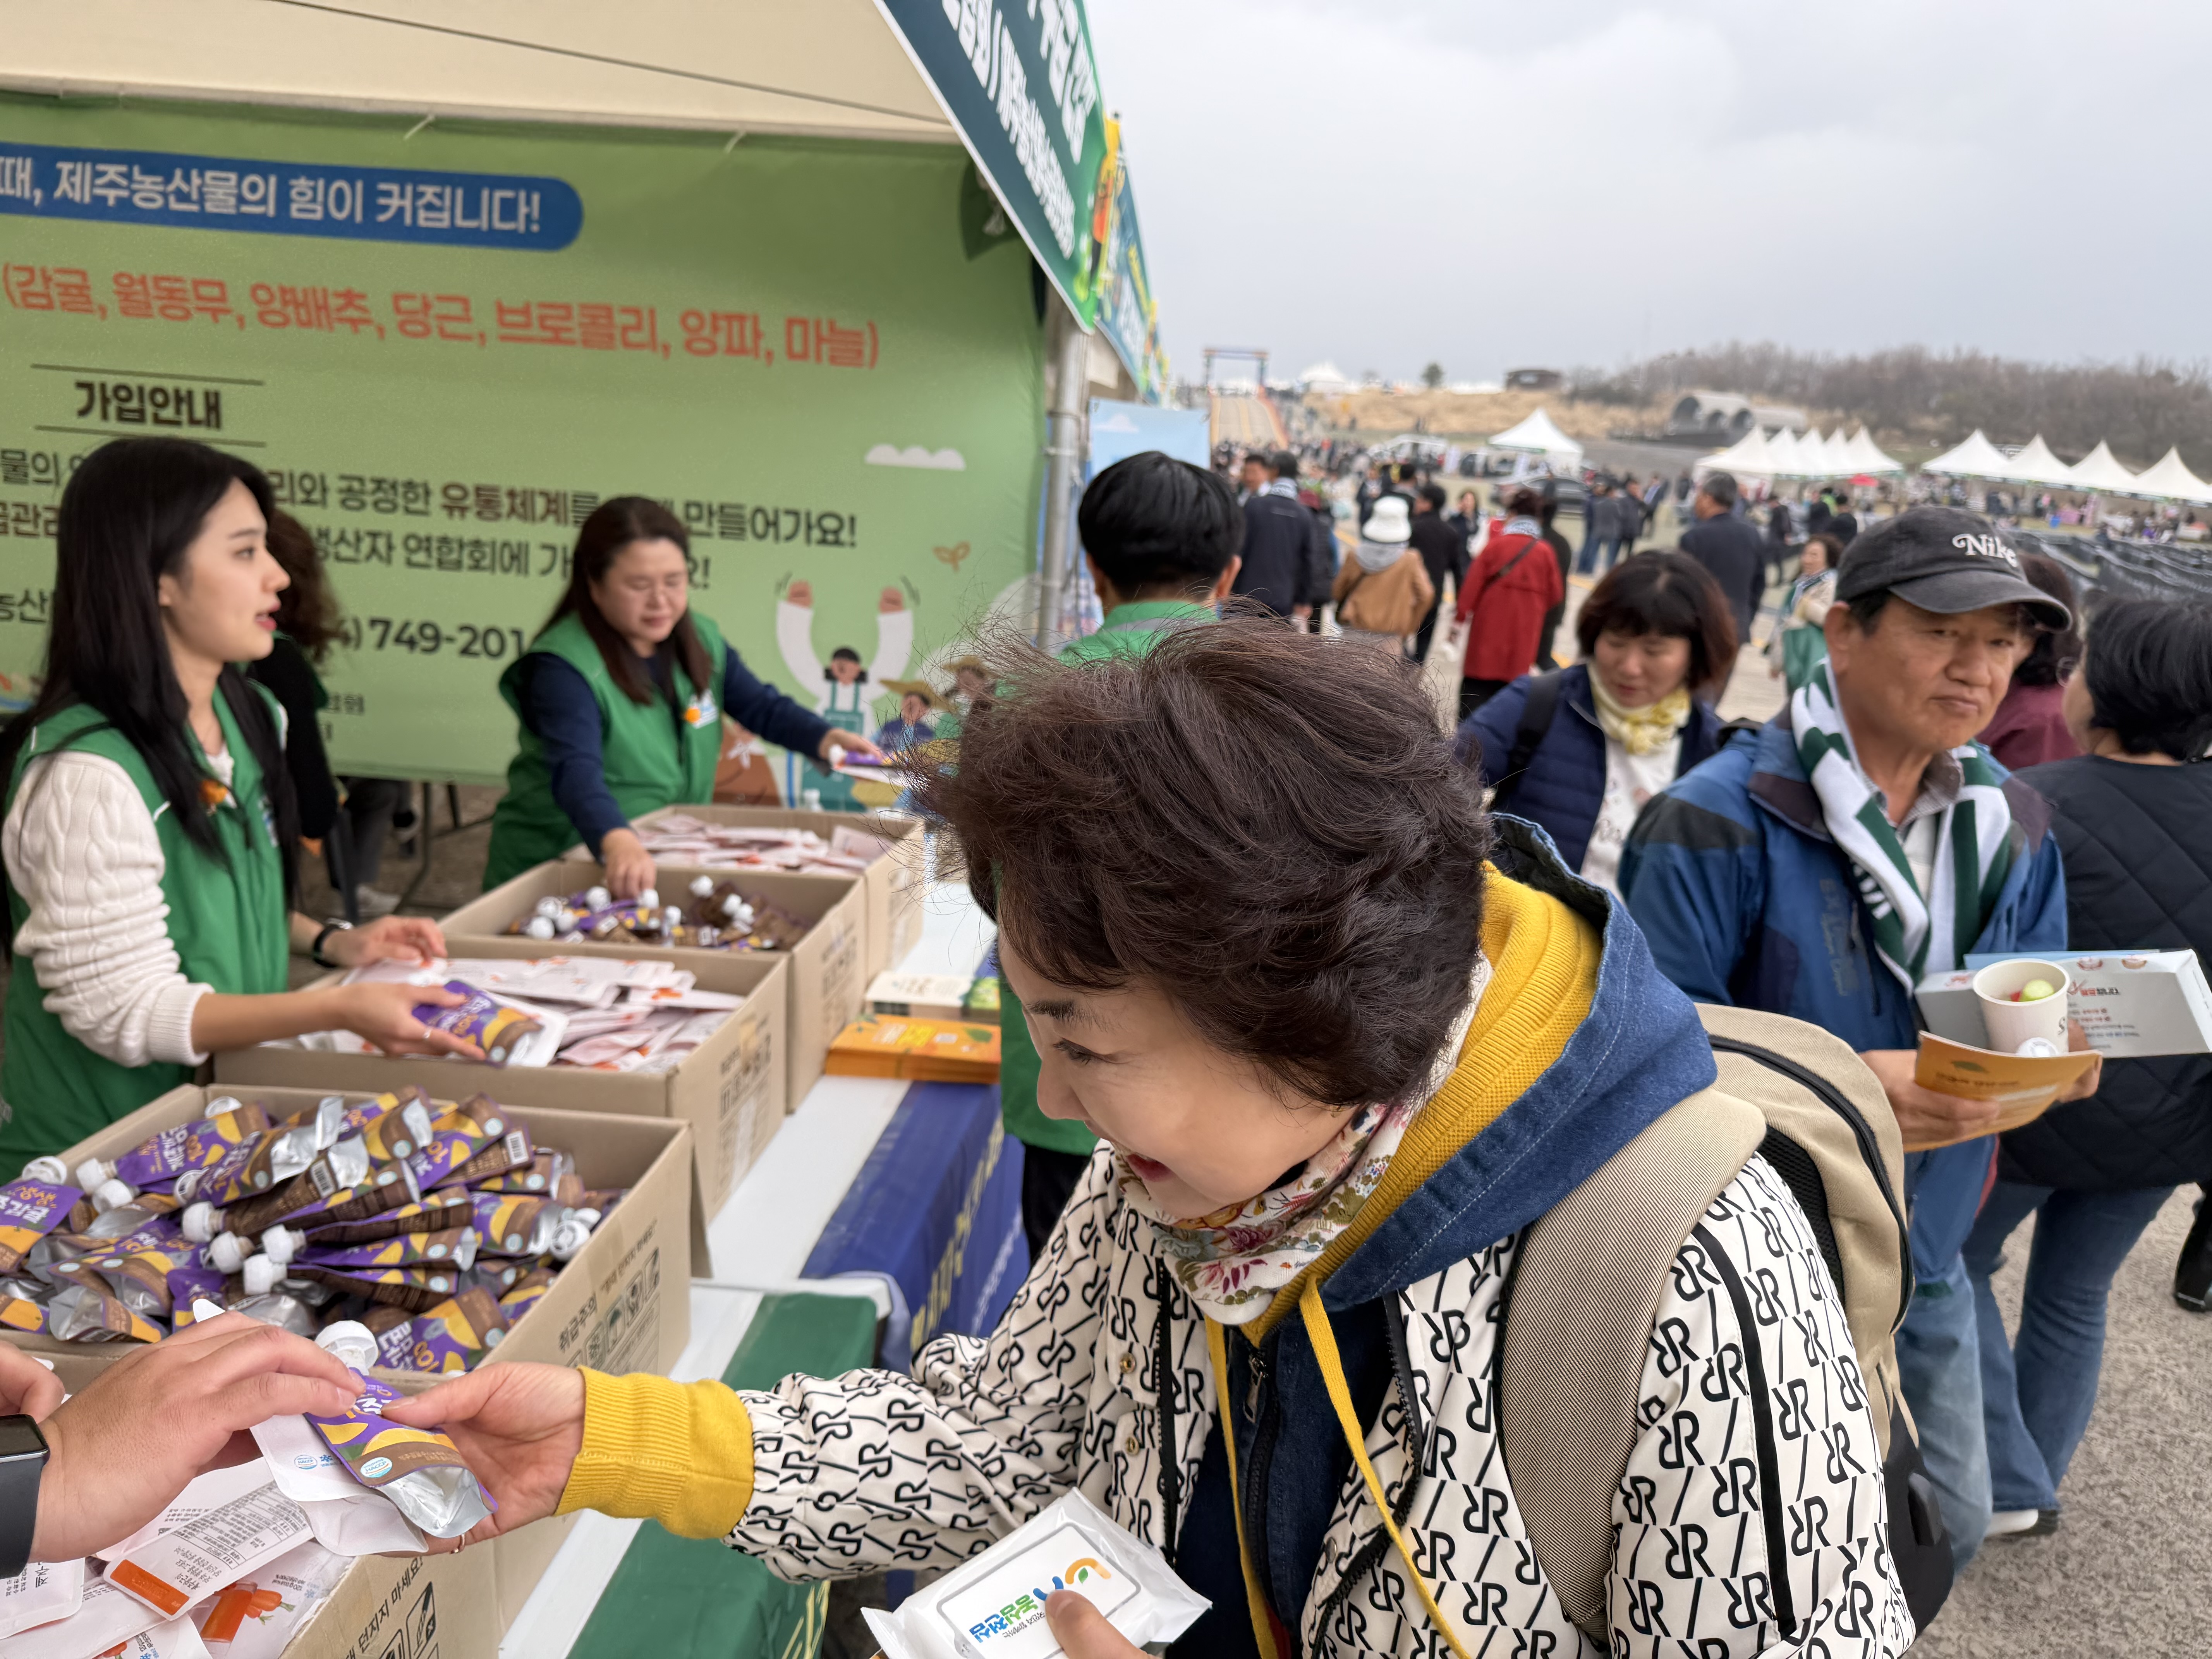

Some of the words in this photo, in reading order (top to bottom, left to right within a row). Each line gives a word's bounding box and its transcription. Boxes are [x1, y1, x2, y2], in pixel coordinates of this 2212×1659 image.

[54, 161, 277, 218] 제주농산물의
[289, 176, 363, 223] 힘이
[376, 182, 540, 233] 커집니다!
[3, 262, 107, 321] (감귤,
[112, 271, 245, 331] 월동무,
[251, 282, 386, 340] 양배추,
[392, 291, 486, 347] 당근,
[495, 299, 671, 360] 브로콜리,
[680, 308, 774, 368] 양파,
[785, 316, 879, 369] 마늘)
[74, 380, 222, 430] 가입안내
[338, 473, 431, 517] 공정한
[685, 501, 857, 548] 만들어가요!
[405, 532, 529, 577] 연합회에
[1952, 534, 2019, 567] Nike
[365, 1462, 386, 1472] HACCP
[358, 1599, 389, 1654] 던지지
